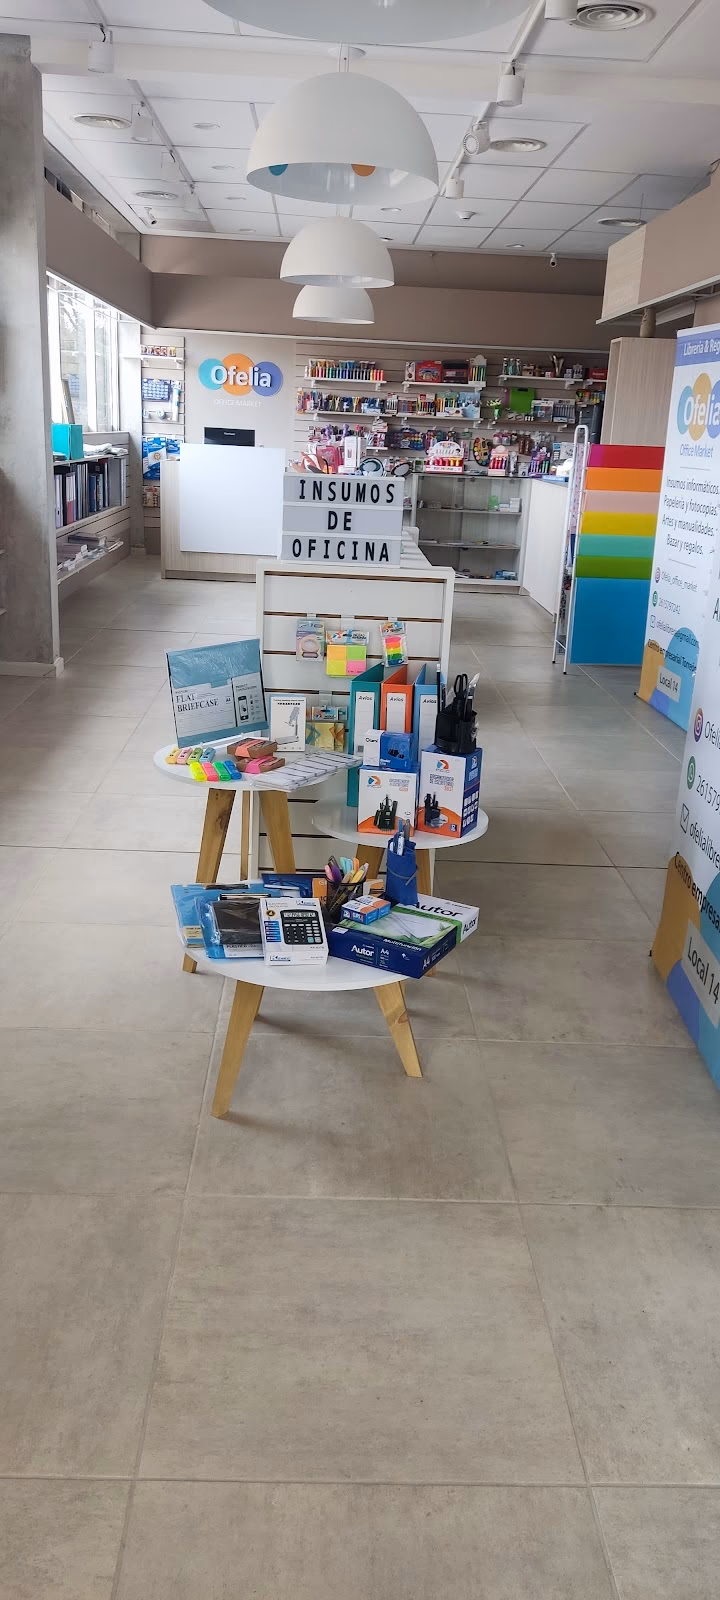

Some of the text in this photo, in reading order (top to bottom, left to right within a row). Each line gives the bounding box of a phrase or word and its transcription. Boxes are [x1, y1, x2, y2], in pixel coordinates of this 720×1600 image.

[704, 340, 710, 353] &
[210, 365, 272, 388] Ofelia
[214, 398, 262, 408] OFFICE MARKET
[684, 394, 720, 426] Ofelia
[680, 443, 714, 458] Office Market
[299, 479, 395, 504] INSUMOS
[666, 476, 686, 490] Insumos
[328, 510, 352, 530] DE
[292, 538, 390, 562] OFICINA
[660, 672, 678, 693] Local 14
[176, 692, 196, 703] FLAT
[177, 698, 219, 712] BRIEFCASE
[696, 775, 720, 816] 261579
[674, 852, 692, 890] Centro
[411, 901, 463, 917] Autor
[462, 916, 477, 934] Autor
[352, 944, 375, 957] Autor
[380, 948, 389, 956] A4
[422, 956, 430, 971] A4
[687, 936, 719, 1004] Local 14
